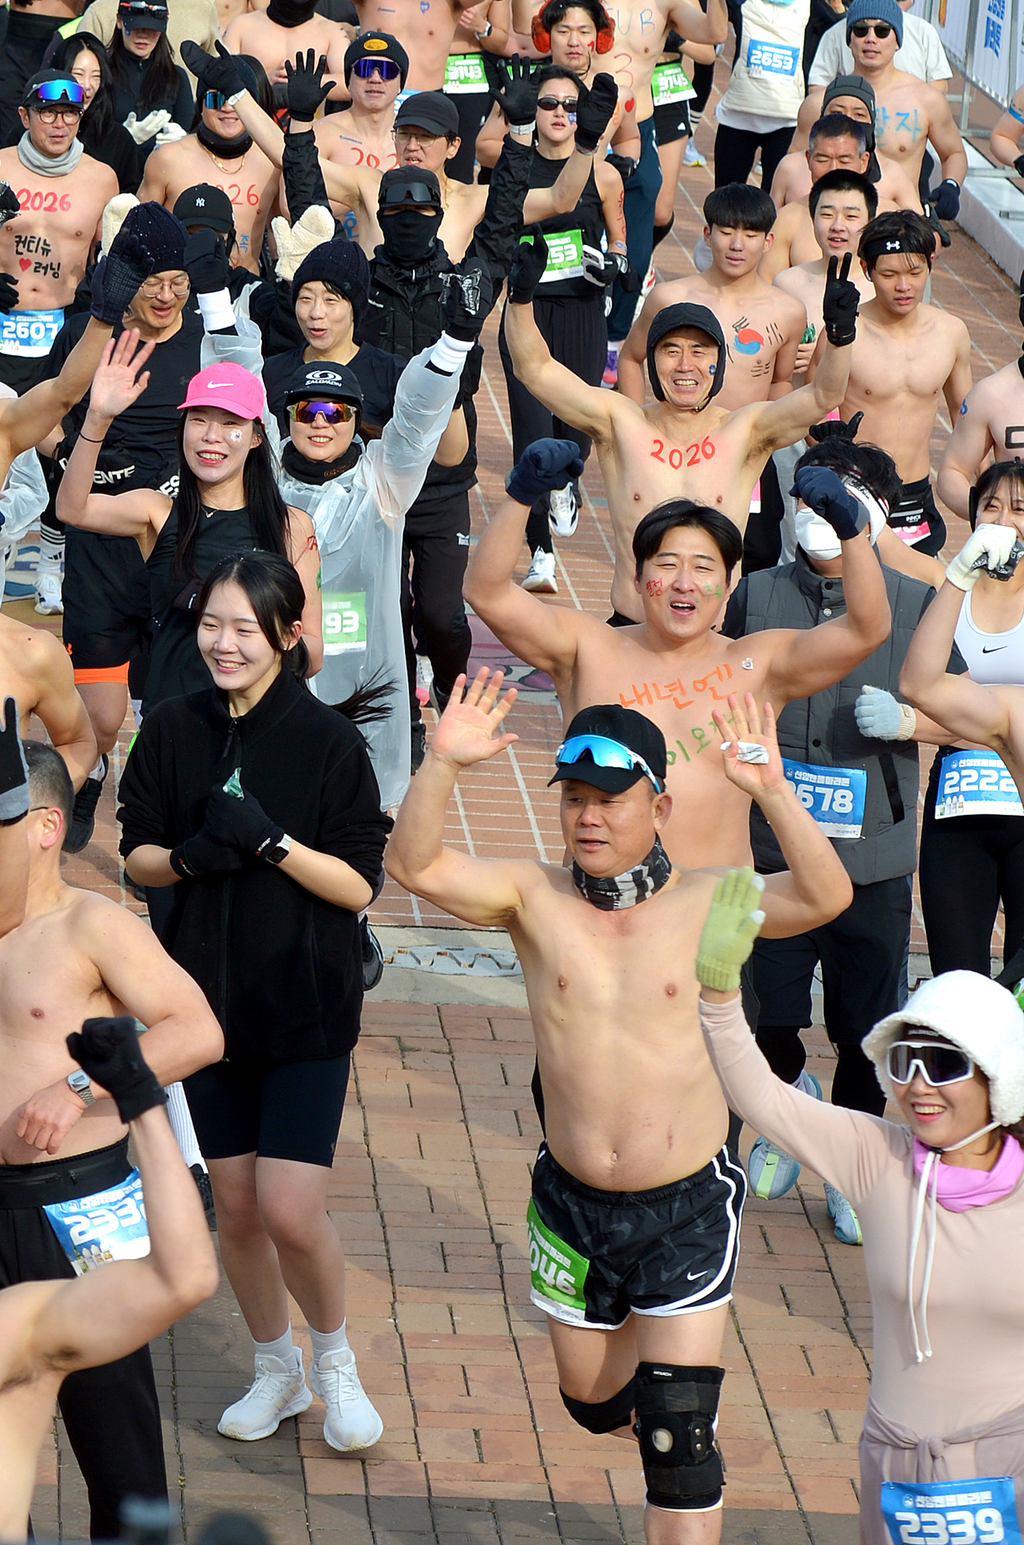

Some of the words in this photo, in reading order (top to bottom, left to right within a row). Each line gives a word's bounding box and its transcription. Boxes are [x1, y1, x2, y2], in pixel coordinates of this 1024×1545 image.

[750, 48, 794, 71] 2653
[446, 66, 483, 81] 3143
[657, 73, 688, 90] 3145
[350, 147, 397, 167] 202
[14, 188, 72, 214] 2026
[14, 234, 53, 258] 컨티뉴
[33, 258, 61, 279] 러닝
[3, 320, 59, 340] 2607
[650, 436, 716, 470] 2026
[326, 610, 360, 634] 93
[527, 1235, 577, 1297] 046
[894, 1507, 1005, 1545] 2339
